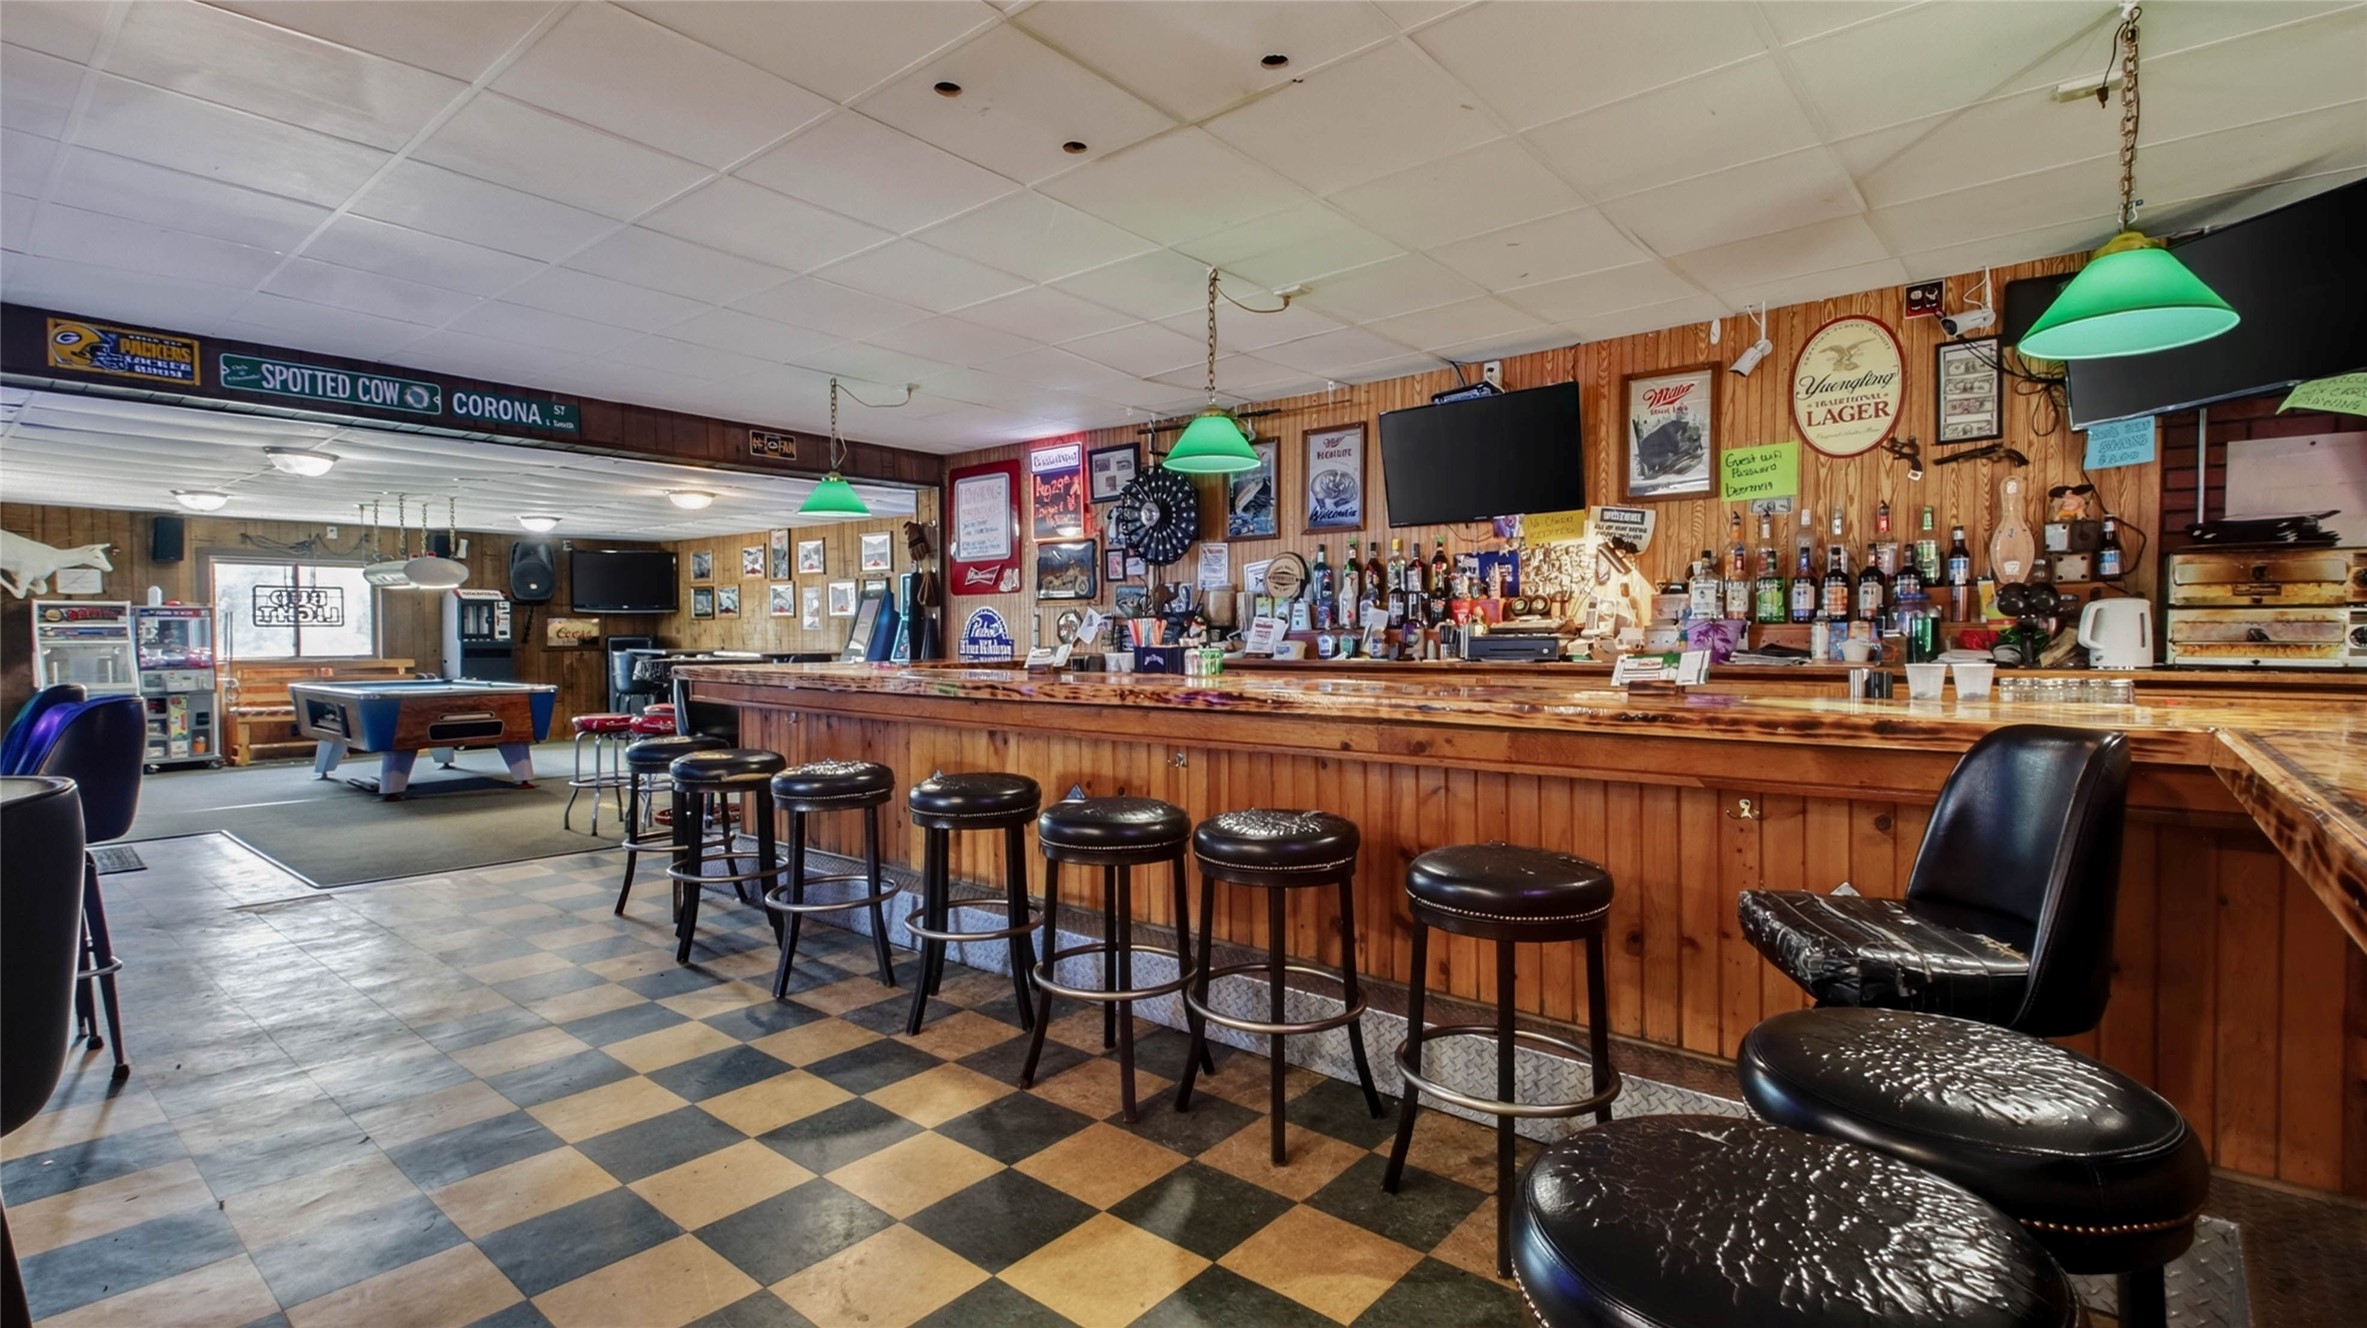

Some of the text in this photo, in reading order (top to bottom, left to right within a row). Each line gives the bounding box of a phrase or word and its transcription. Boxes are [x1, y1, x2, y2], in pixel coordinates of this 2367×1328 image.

[261, 363, 350, 398] SPOTTED
[357, 377, 400, 406] COW
[1642, 382, 1696, 410] Miller
[1796, 364, 1899, 401] Yuengling
[452, 392, 542, 425] CORONA
[1806, 401, 1890, 427] LAGER
[1815, 392, 1882, 408] TRADITIONAL
[1725, 453, 1755, 468] Guest
